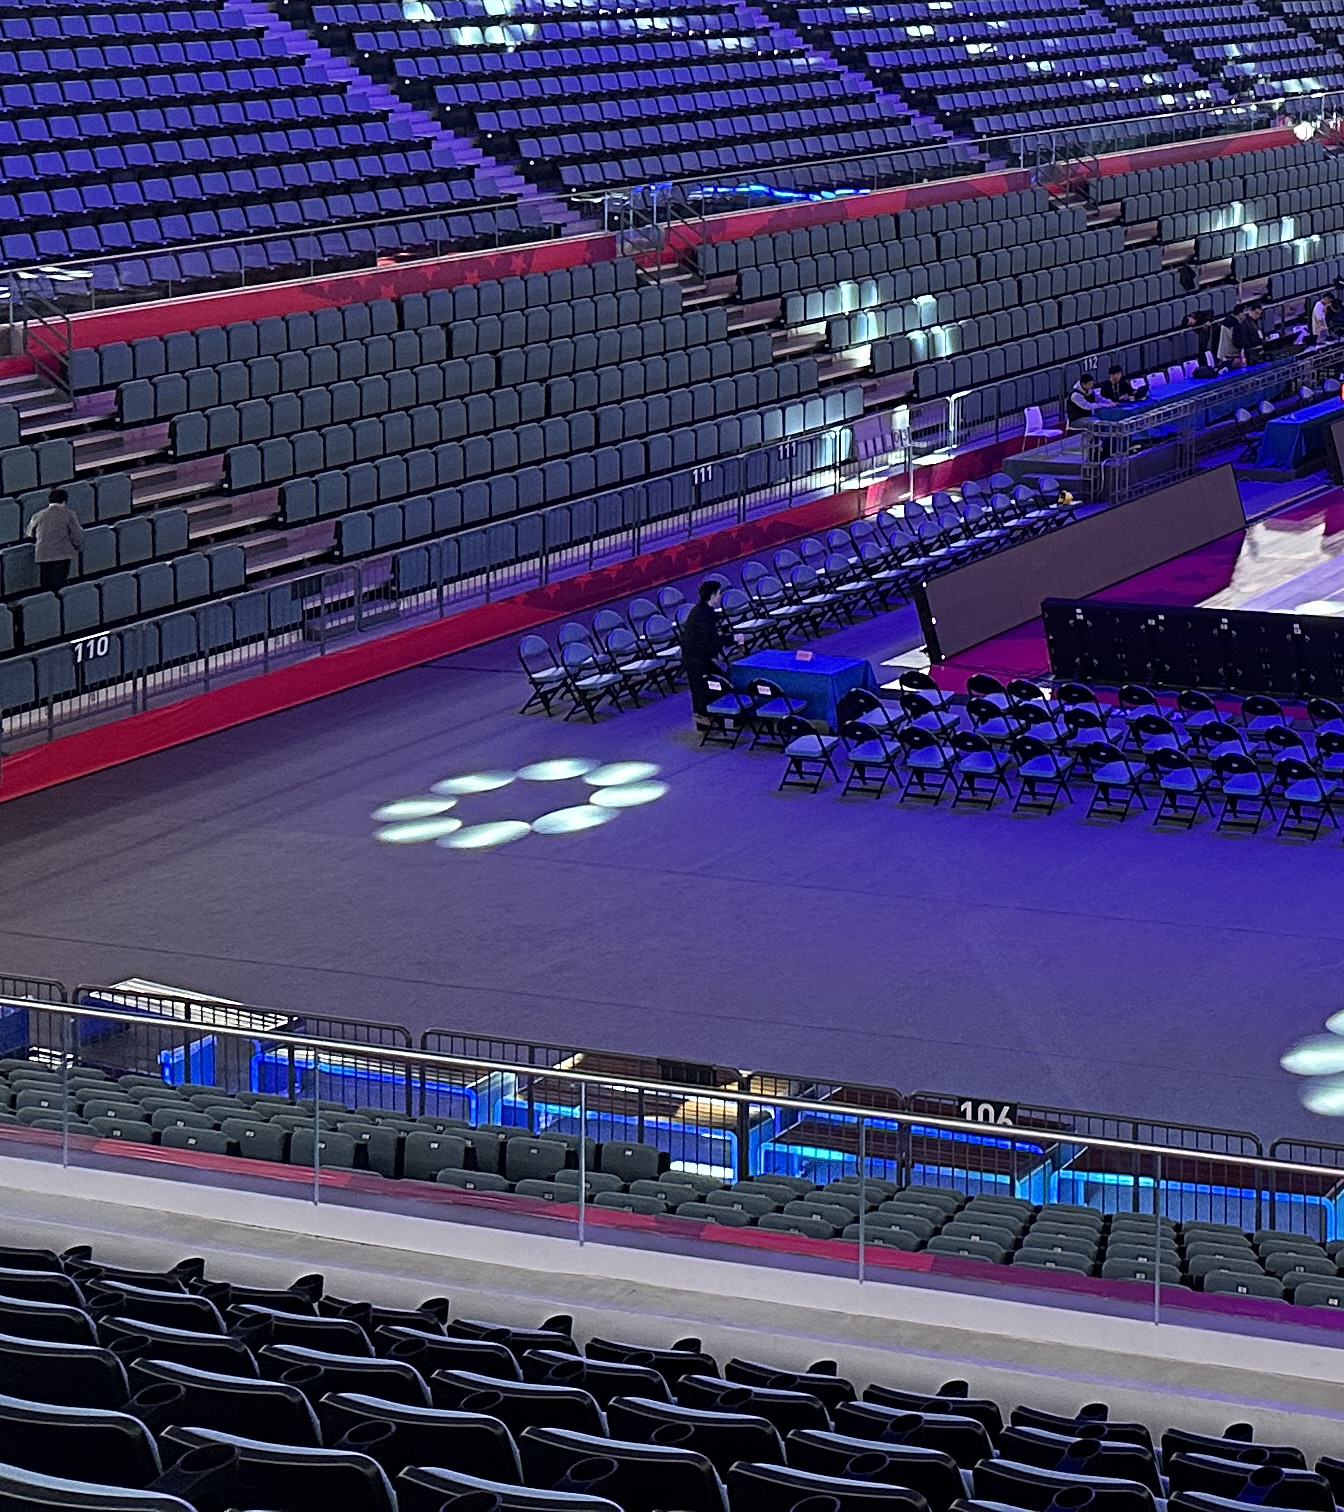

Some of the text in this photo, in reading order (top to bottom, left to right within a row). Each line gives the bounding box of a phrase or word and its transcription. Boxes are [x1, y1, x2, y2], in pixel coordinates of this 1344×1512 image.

[1083, 357, 1099, 370] 112
[777, 443, 798, 461] 111
[692, 465, 713, 485] 111
[74, 635, 109, 663] 110
[959, 1101, 1013, 1126] 106
